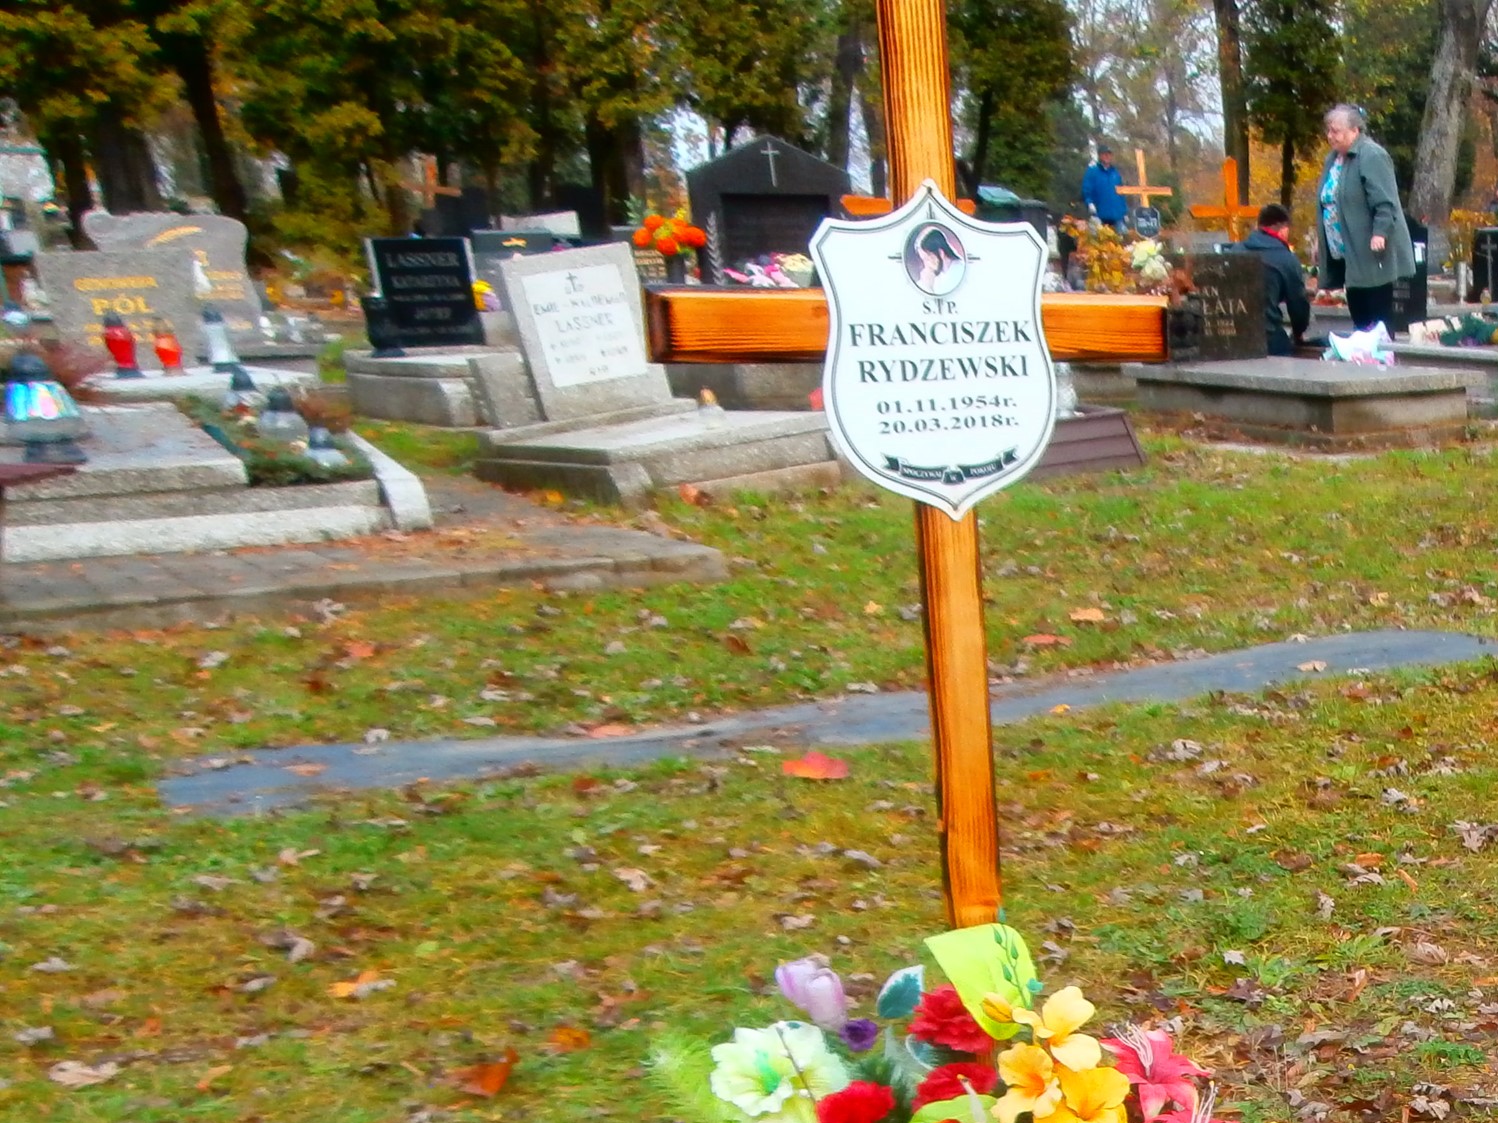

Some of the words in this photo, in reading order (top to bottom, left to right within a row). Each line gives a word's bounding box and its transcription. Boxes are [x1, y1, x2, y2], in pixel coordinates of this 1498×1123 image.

[849, 320, 1032, 347] FRANCISZEK
[857, 355, 1029, 383] RYDZEWSKI
[877, 396, 1018, 415] 01.11.1954r.
[878, 415, 1019, 434] 20.03.2018r.
